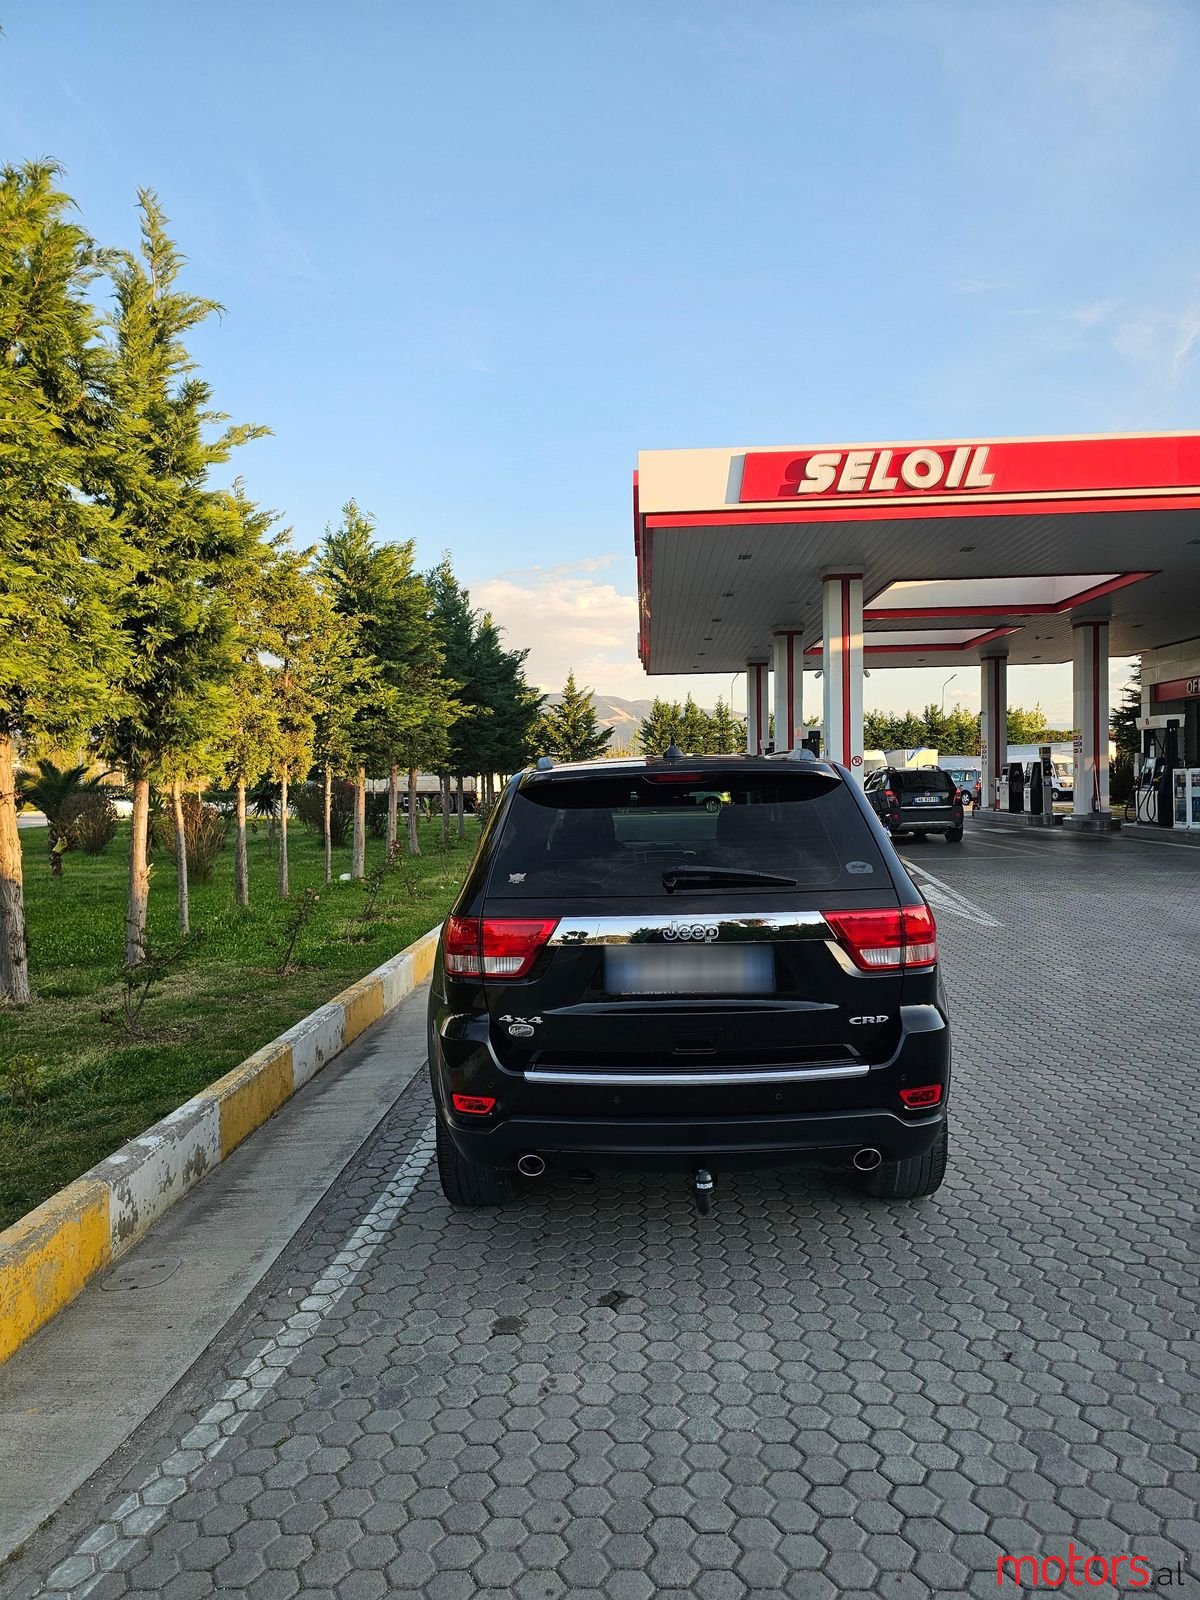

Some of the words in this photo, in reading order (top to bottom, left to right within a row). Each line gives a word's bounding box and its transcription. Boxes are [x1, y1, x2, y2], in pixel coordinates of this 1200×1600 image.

[797, 446, 995, 495] SELOIL
[663, 920, 720, 943] Jeep
[498, 1014, 544, 1025] 4x4
[849, 1014, 889, 1025] CRD
